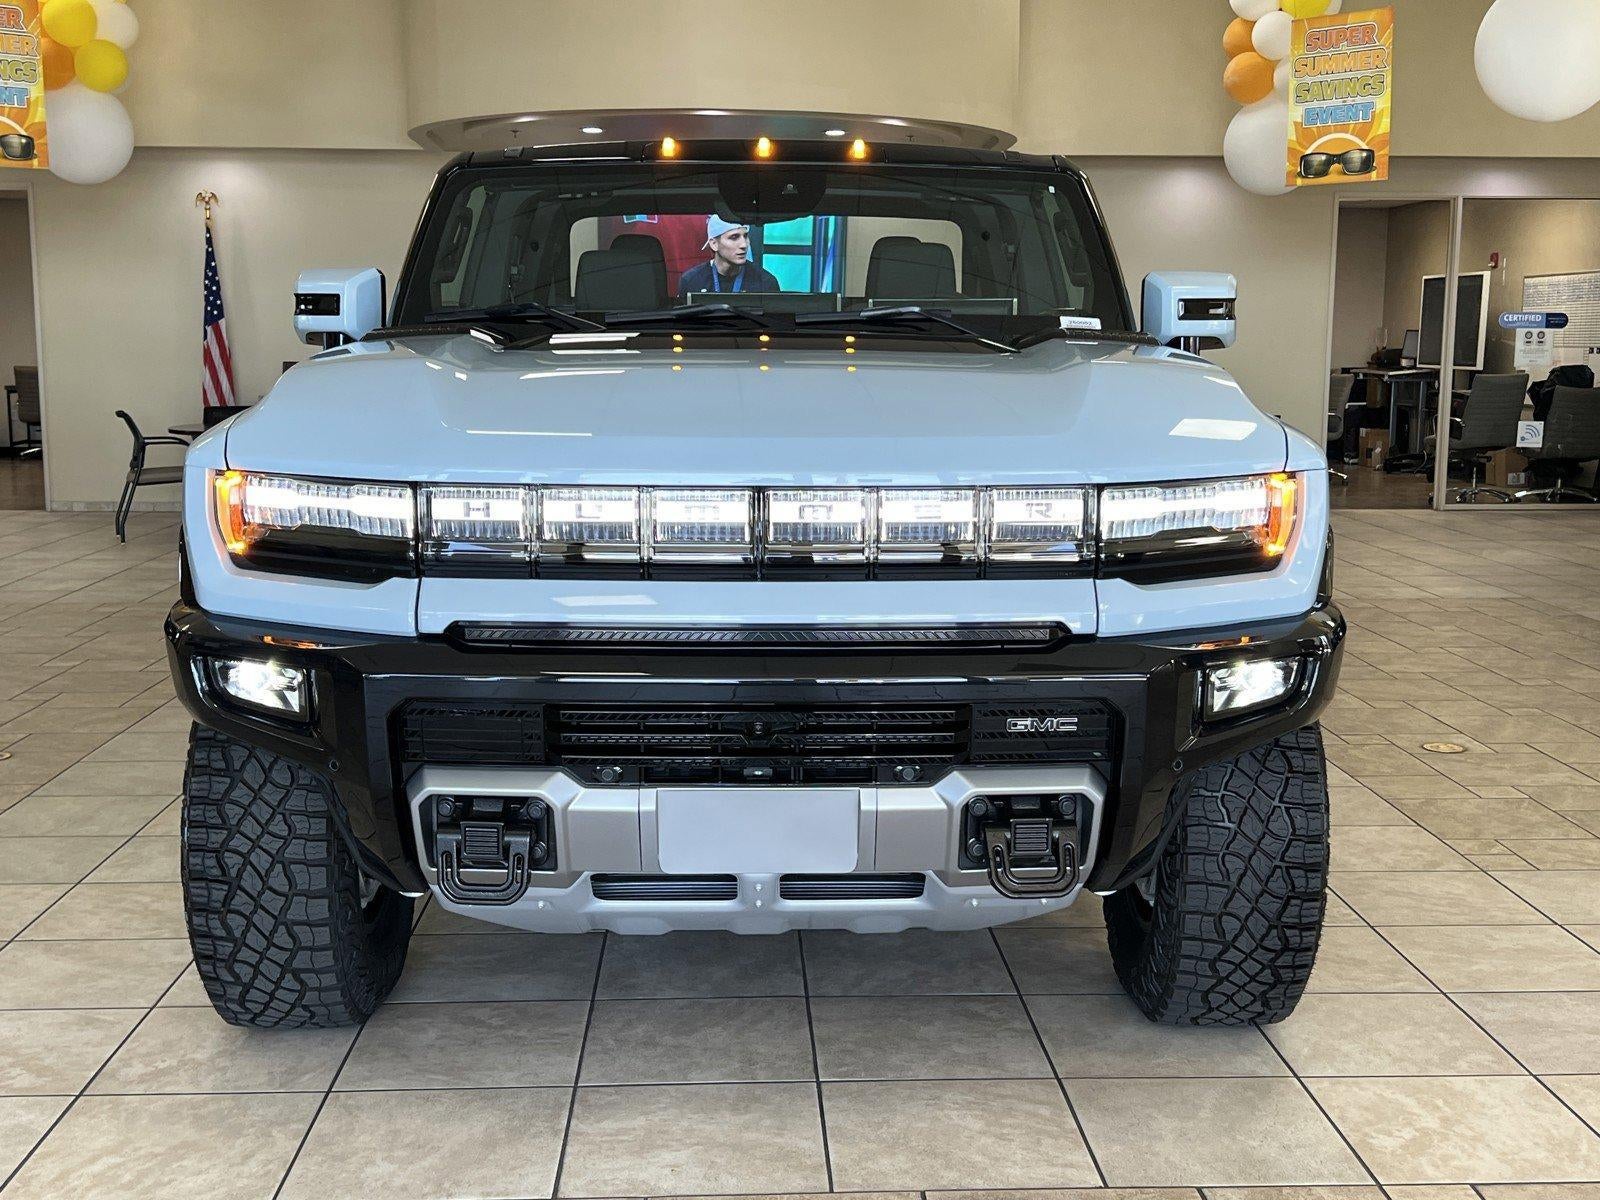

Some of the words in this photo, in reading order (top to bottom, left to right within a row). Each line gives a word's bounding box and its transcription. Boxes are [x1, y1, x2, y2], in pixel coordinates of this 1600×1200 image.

[1306, 24, 1377, 52] SUPER
[1294, 48, 1388, 78] SUMMER
[1295, 75, 1386, 104] SAVINGS
[1304, 102, 1375, 126] EVENT
[1503, 314, 1542, 322] CERTIFIED
[1006, 717, 1078, 732] GMC
